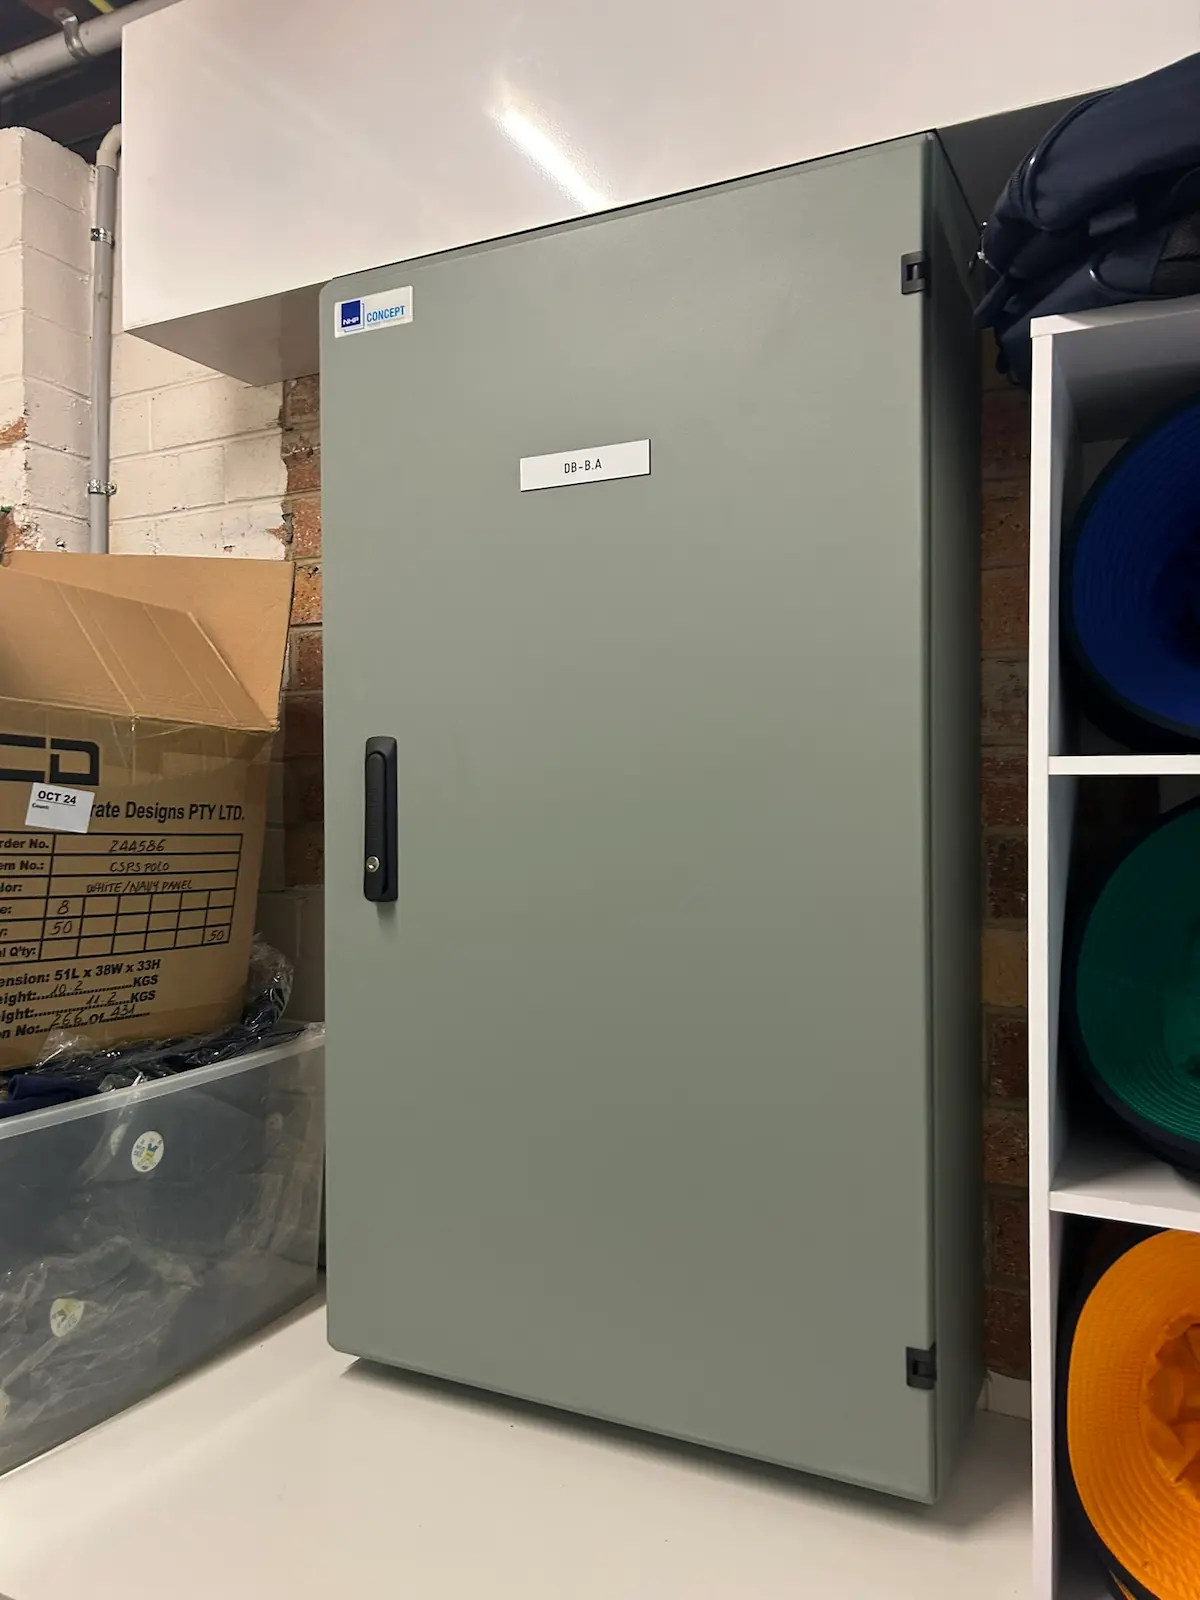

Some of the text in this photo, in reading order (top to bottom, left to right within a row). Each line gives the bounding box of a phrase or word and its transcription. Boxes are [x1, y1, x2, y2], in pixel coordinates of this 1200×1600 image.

[366, 304, 406, 323] CONCEPT
[564, 458, 602, 474] DB-B.A
[37, 790, 77, 805] OCT 24
[125, 800, 184, 823] Designs
[188, 803, 216, 820] PTY
[219, 804, 246, 821] LTD.
[29, 838, 49, 849] No.
[143, 861, 169, 873] POLO
[162, 879, 193, 890] PANEL
[57, 900, 69, 915] 8
[50, 920, 72, 936] 50
[208, 929, 224, 942] 50
[54, 967, 79, 981] 51L
[83, 968, 92, 978] x
[95, 963, 123, 977] 38W
[125, 963, 134, 973] x
[136, 958, 161, 971] 33H
[133, 974, 158, 988] KGS
[130, 990, 156, 1004] KGS
